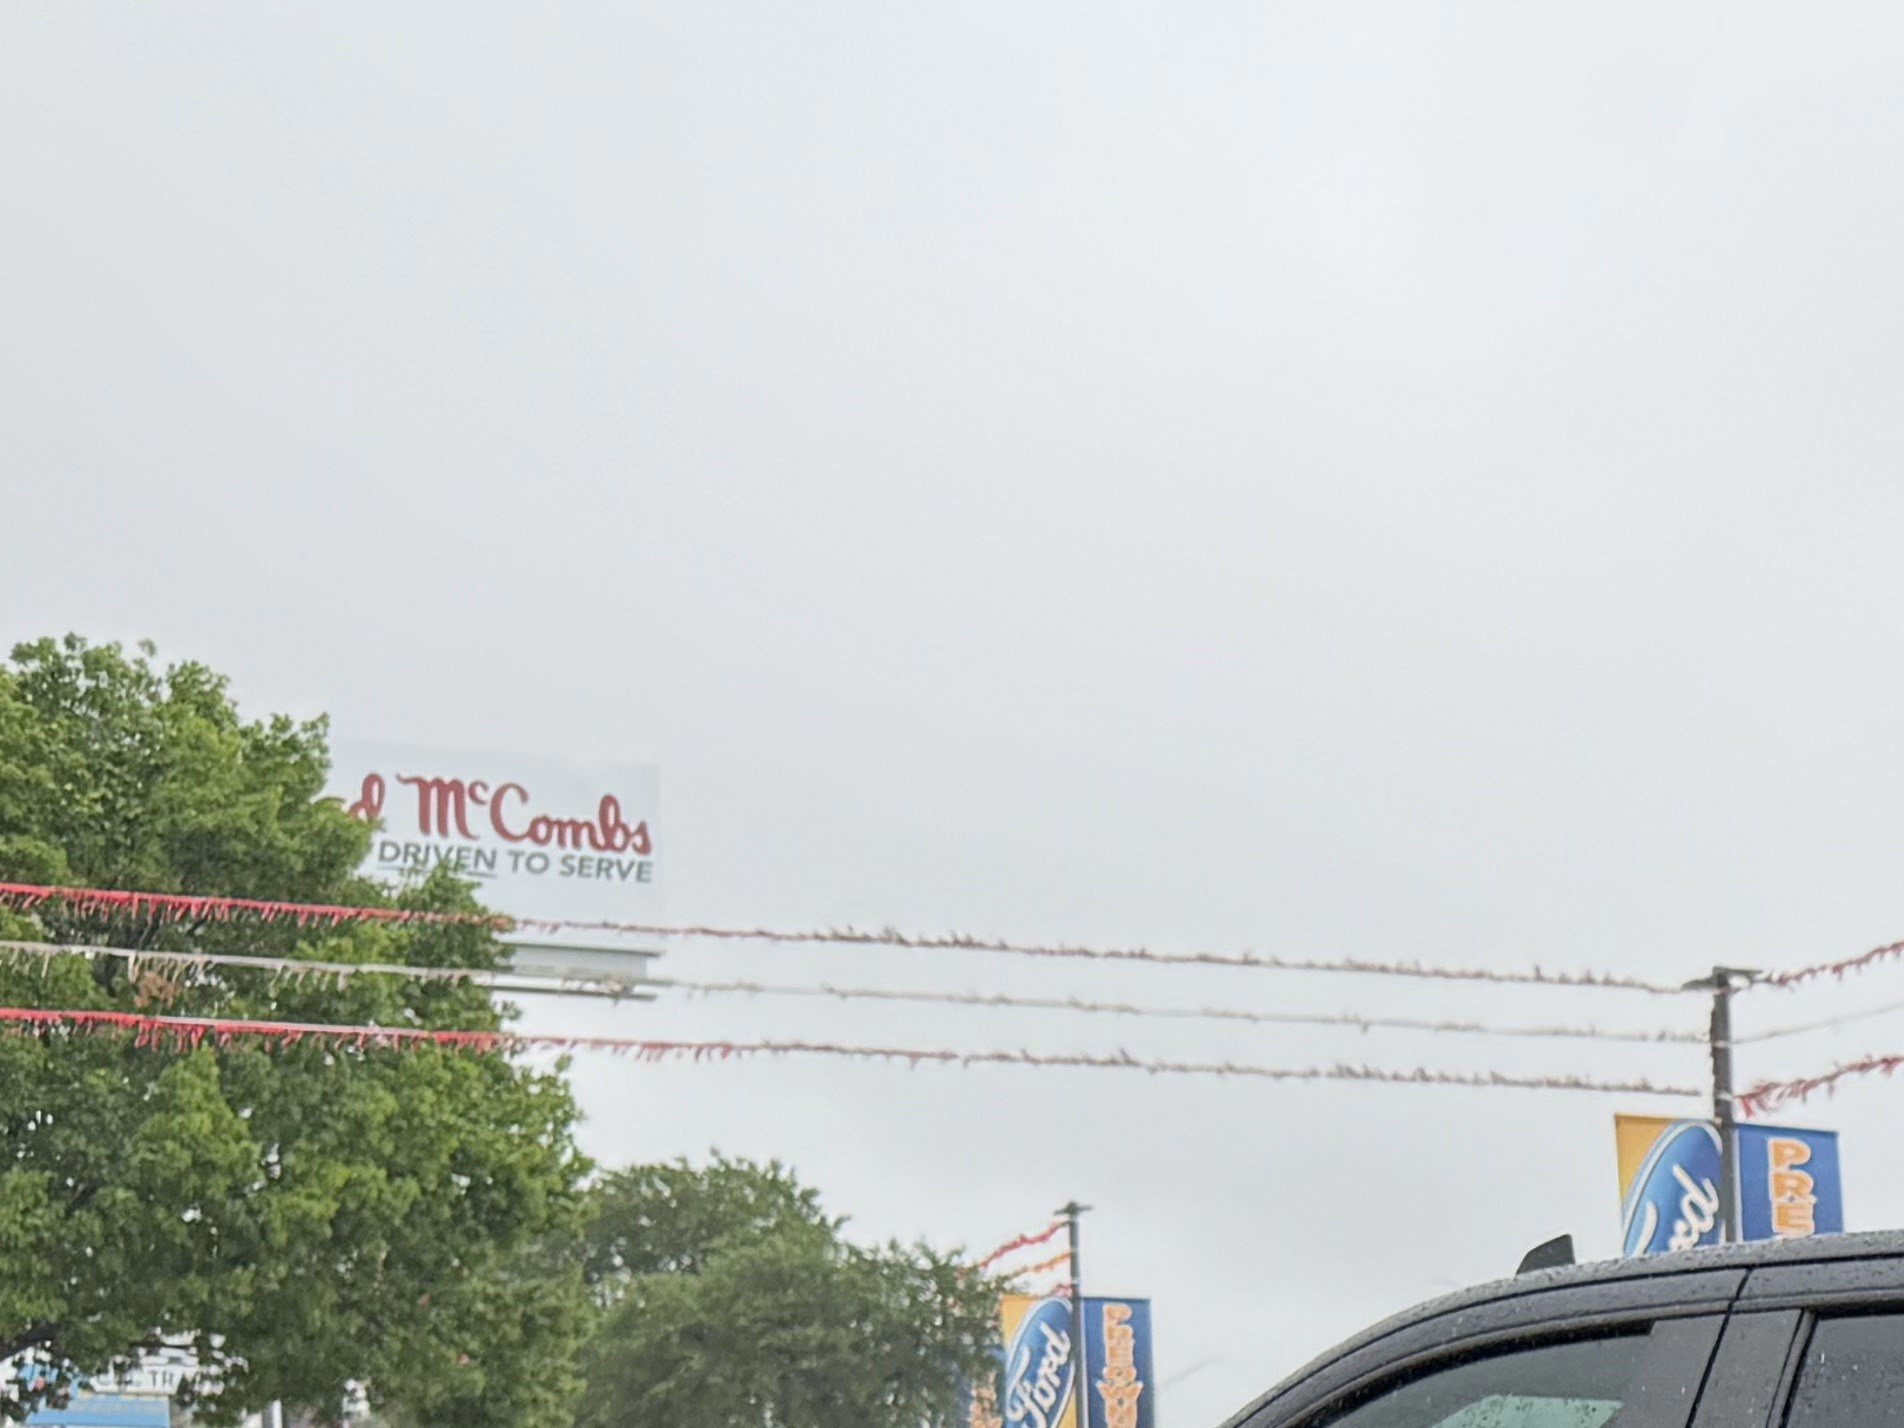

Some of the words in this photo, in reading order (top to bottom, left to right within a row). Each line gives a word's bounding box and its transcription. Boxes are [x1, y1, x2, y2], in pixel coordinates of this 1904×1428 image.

[395, 773, 652, 855] McCombs
[378, 840, 498, 872] DRIVEN
[508, 850, 551, 875] TO
[559, 854, 653, 883] SERVE
